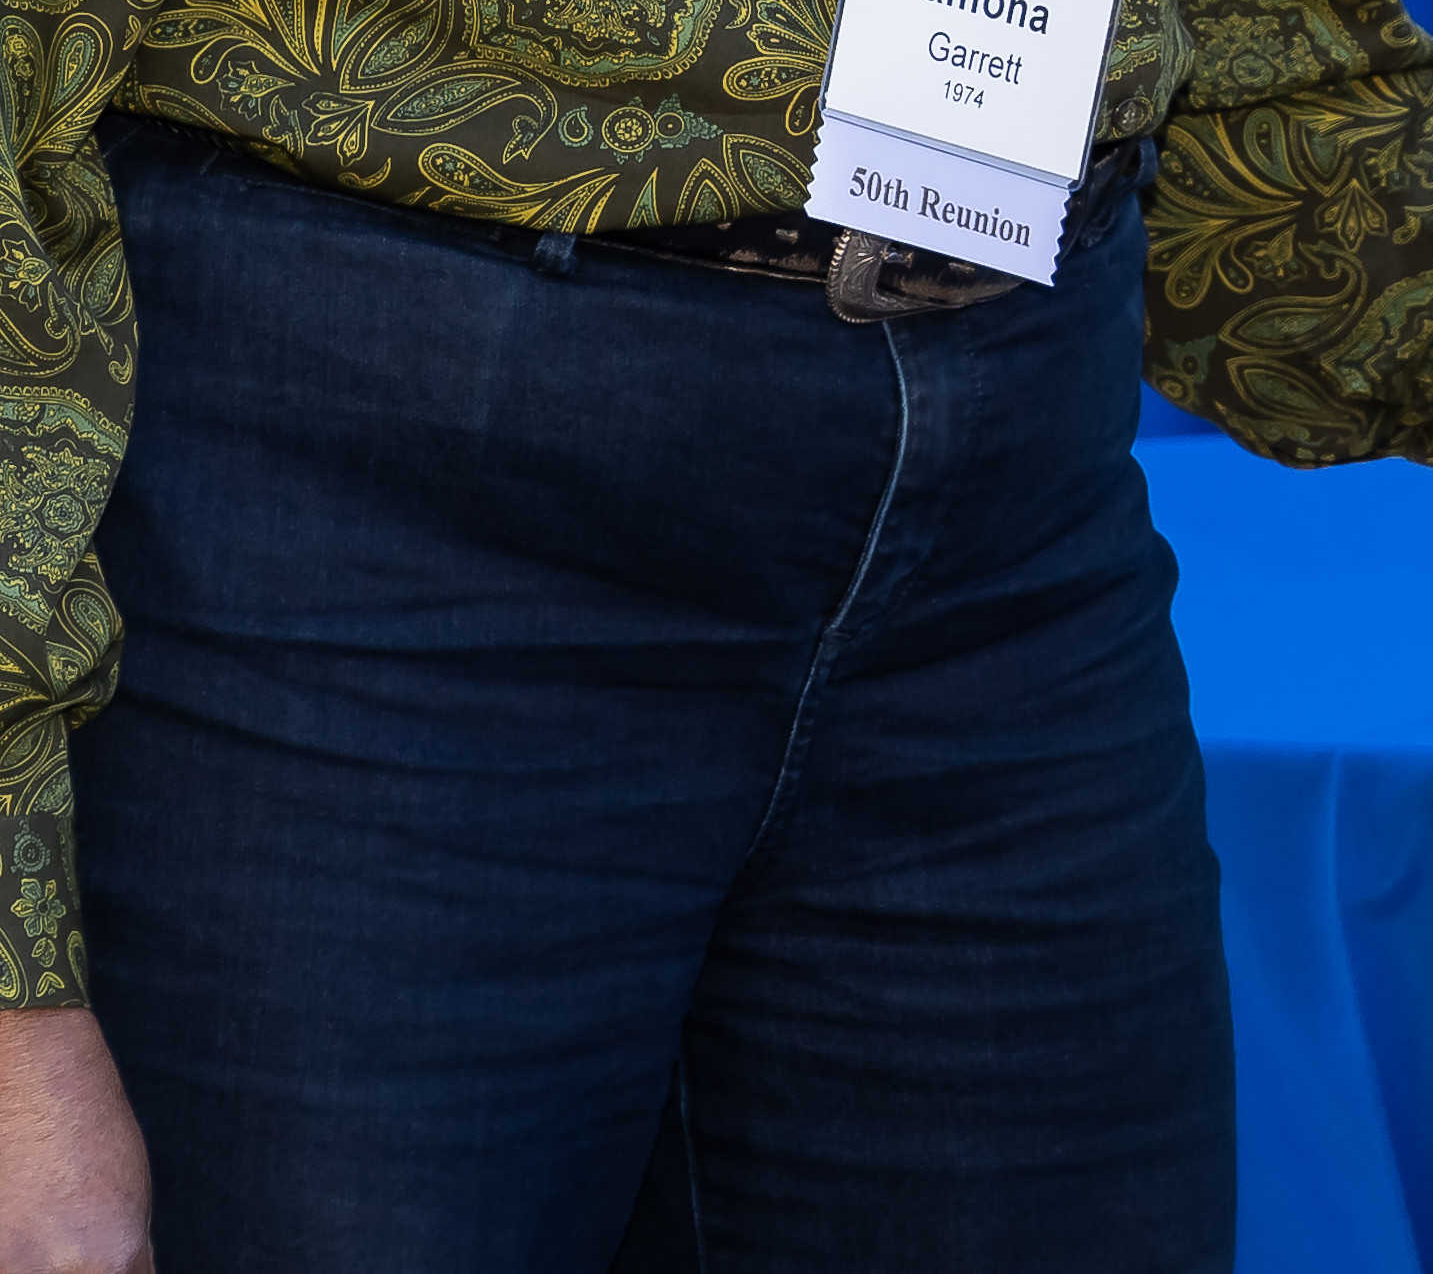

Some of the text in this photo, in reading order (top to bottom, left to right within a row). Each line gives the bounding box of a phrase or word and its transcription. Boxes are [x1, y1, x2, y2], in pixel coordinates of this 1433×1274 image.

[927, 32, 1024, 86] Garrett
[943, 80, 985, 109] 1974
[849, 166, 1032, 248] 50th Reunion
